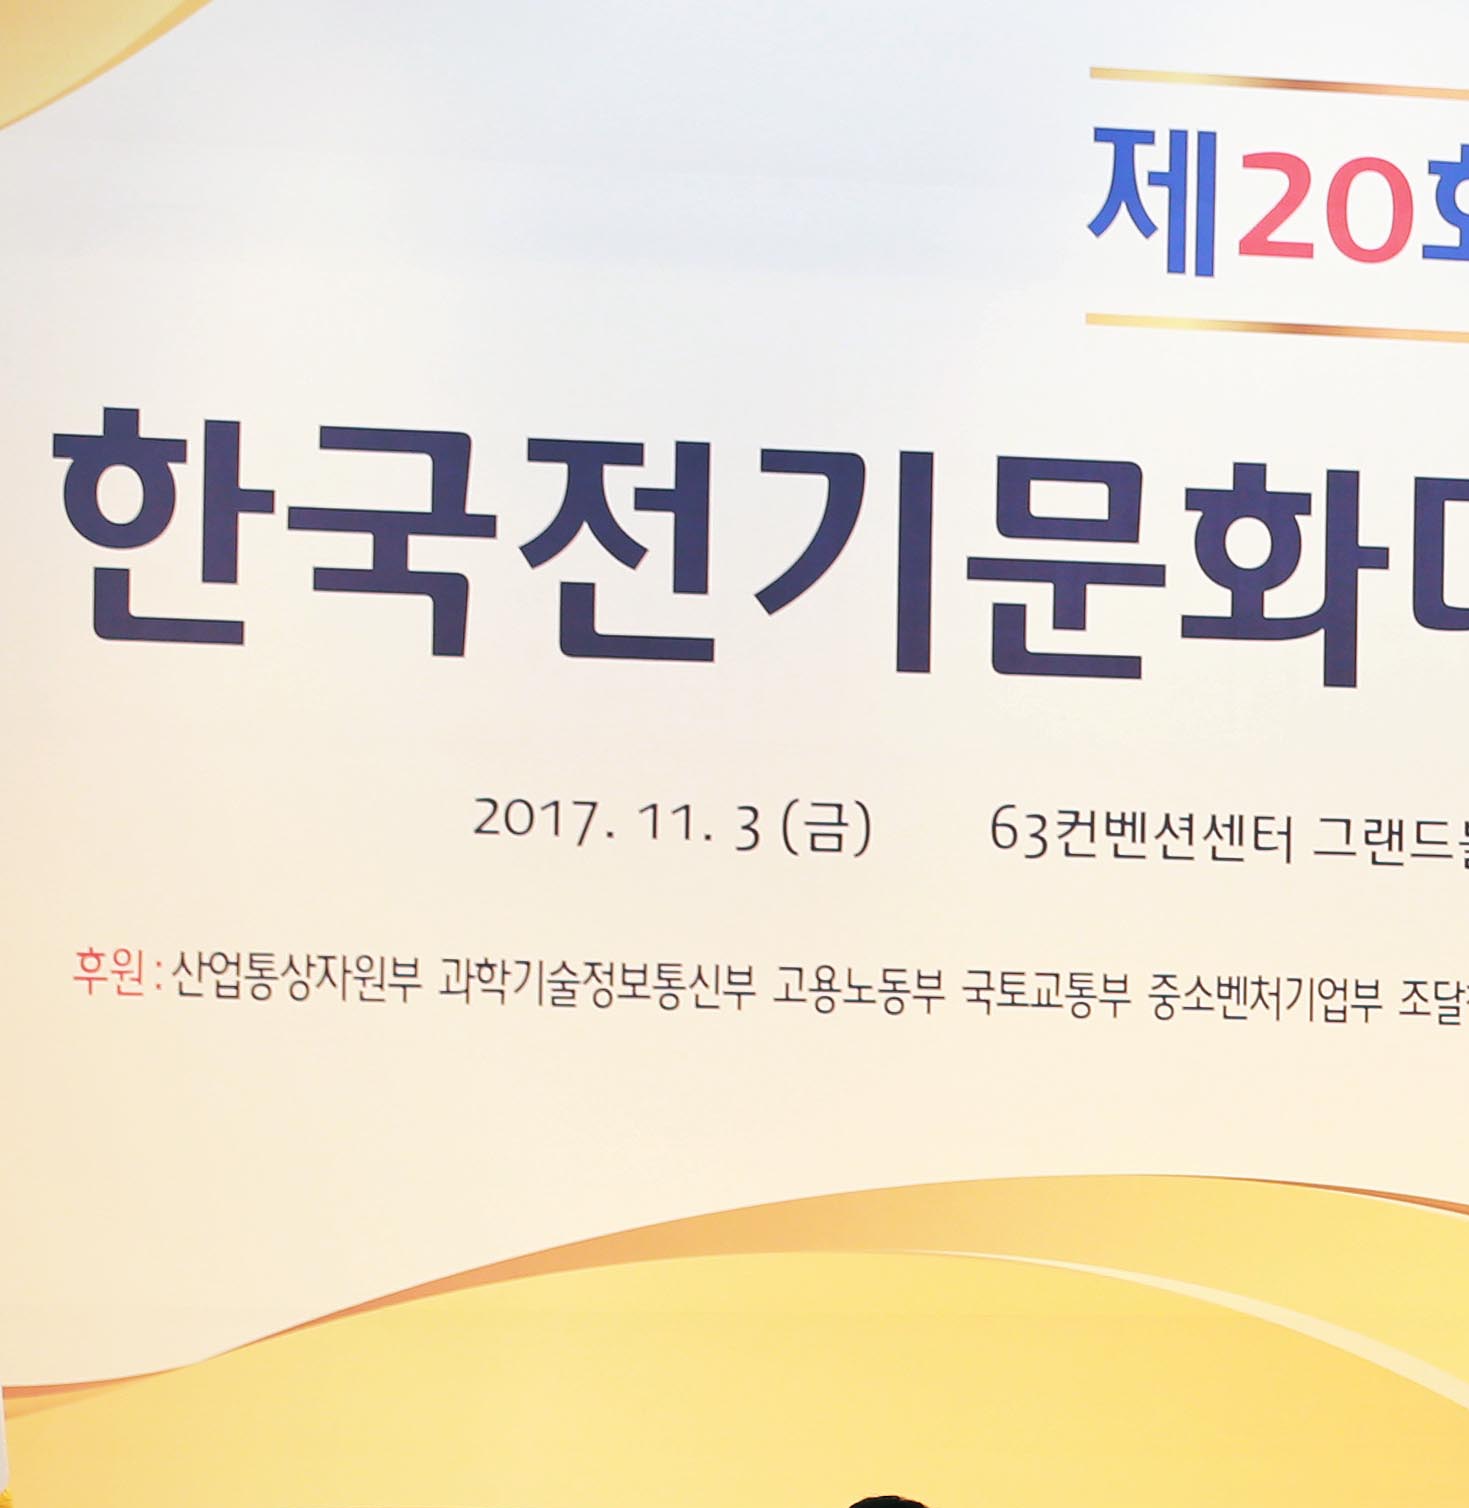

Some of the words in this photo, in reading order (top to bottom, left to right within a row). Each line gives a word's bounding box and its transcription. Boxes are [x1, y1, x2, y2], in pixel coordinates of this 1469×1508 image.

[473, 797, 614, 847] 2017.
[638, 802, 713, 842] 11.
[991, 803, 1293, 865] 63컨벤션센터
[171, 950, 423, 1004] 산업통상자원부
[438, 956, 757, 1012] 과학기술정보통신부
[772, 964, 946, 1016] 고용노동부
[961, 969, 1133, 1020] 국토교통부
[1147, 973, 1385, 1025] 중소벤처기업부
